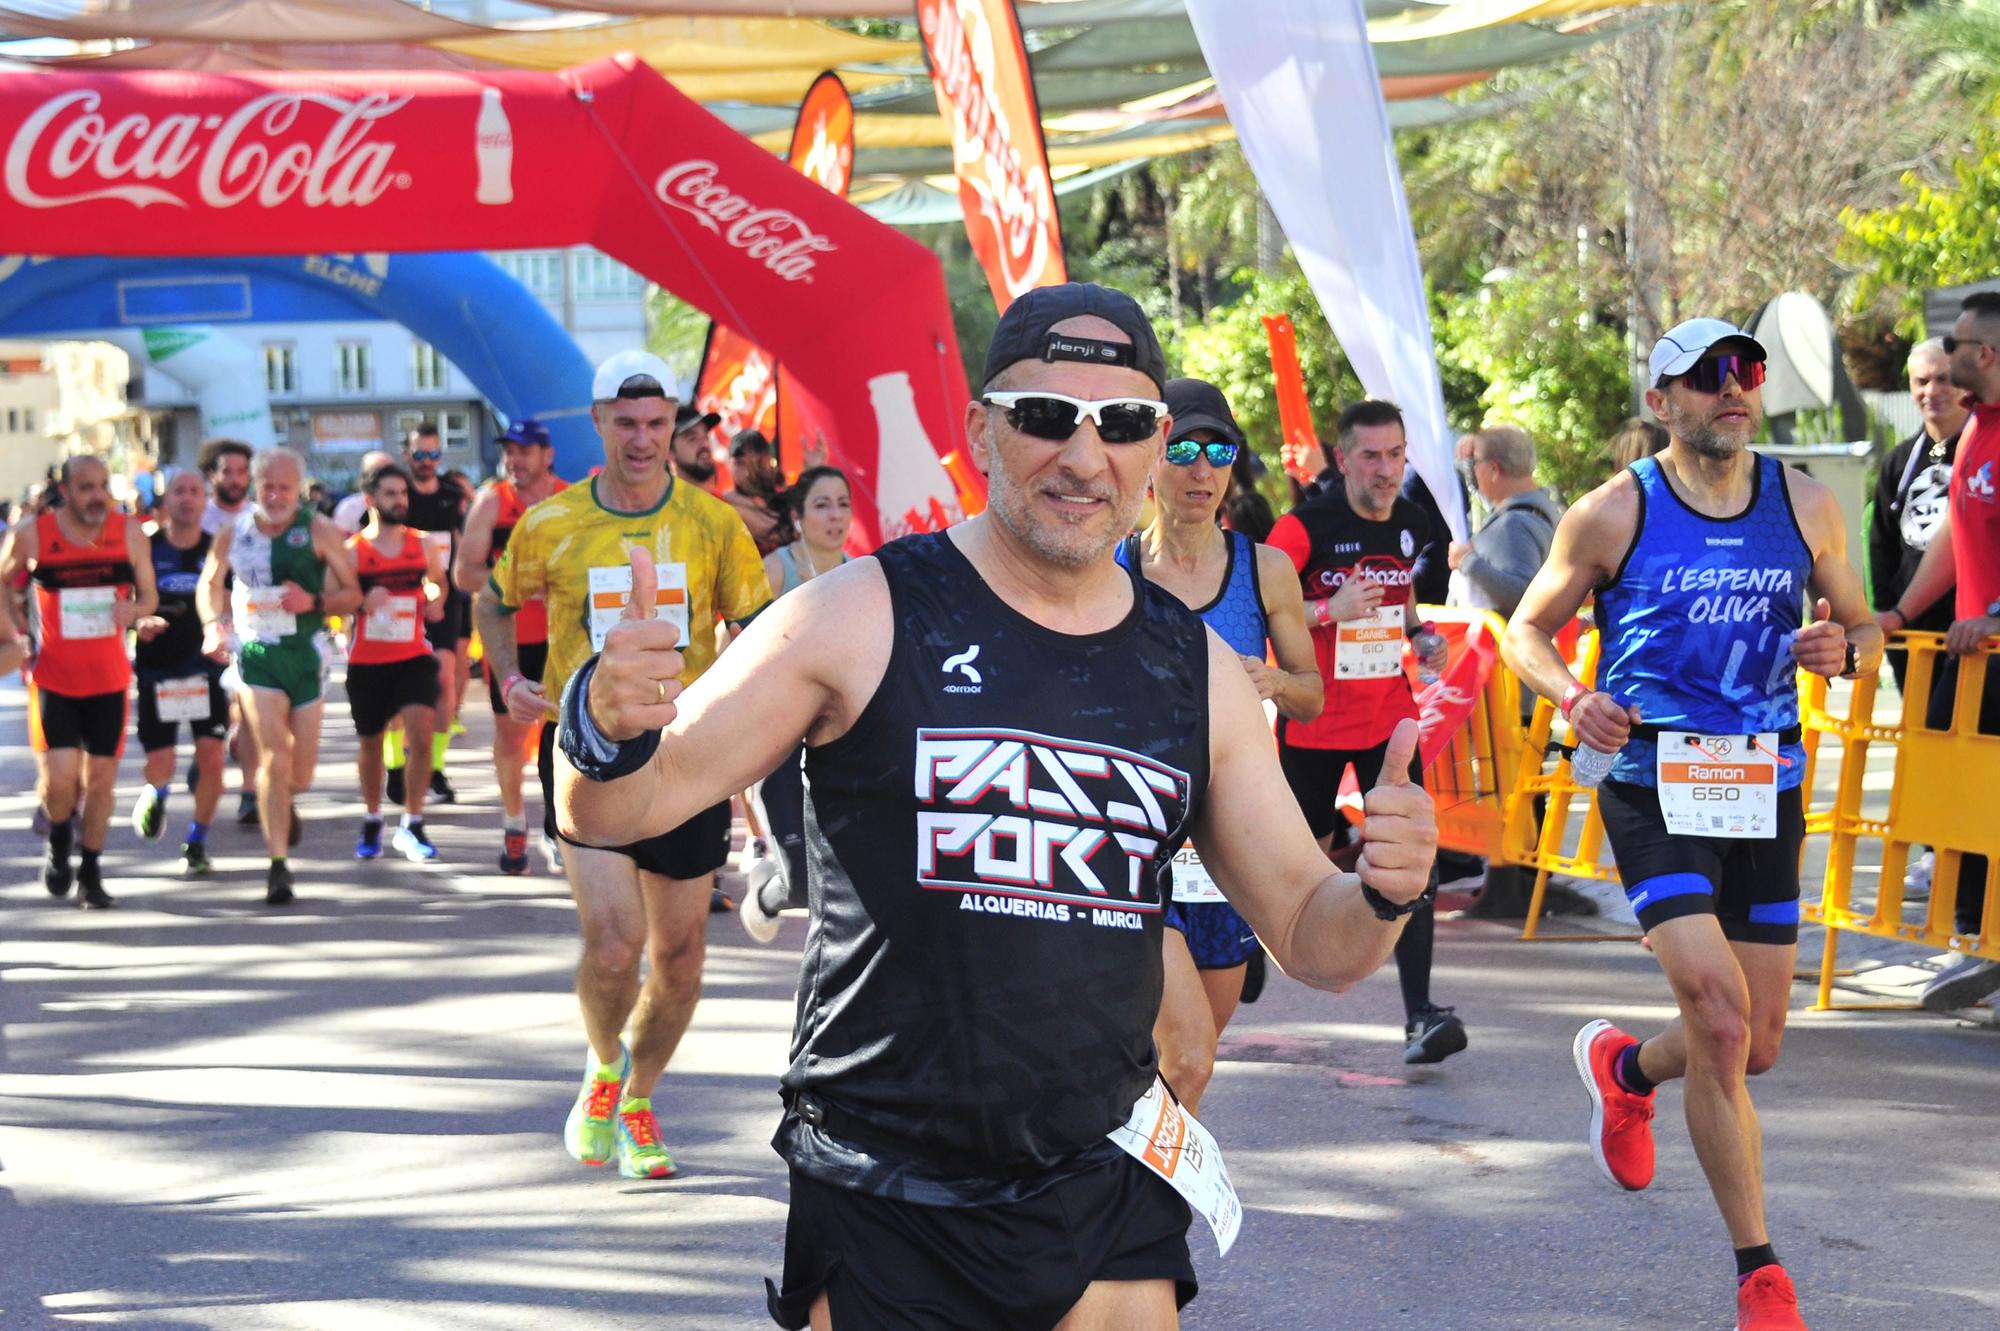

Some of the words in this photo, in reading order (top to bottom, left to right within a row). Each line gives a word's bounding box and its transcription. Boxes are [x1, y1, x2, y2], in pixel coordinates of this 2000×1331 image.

[5, 88, 414, 210] Coca-Cola
[655, 158, 838, 282] Coca-Cola
[1661, 566, 1792, 594] L'ESPENTA
[1687, 595, 1770, 624] OLIVA
[1688, 765, 1744, 780] Ramon
[1692, 787, 1740, 801] 650
[960, 893, 1070, 922] ALQUERIAS
[1092, 908, 1143, 930] MURCIA
